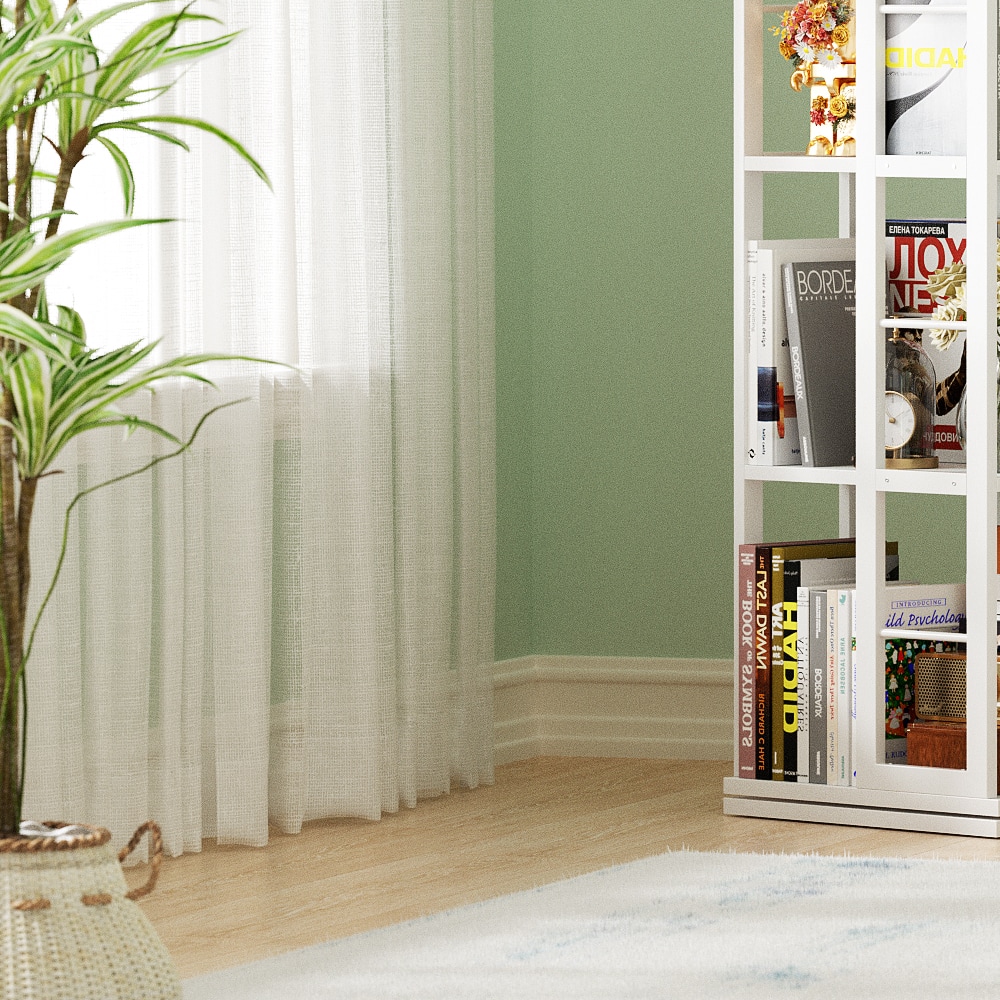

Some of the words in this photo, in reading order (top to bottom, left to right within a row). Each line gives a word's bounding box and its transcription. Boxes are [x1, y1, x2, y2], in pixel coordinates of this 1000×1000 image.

[889, 225, 910, 234] ЕЛЕНА
[911, 226, 946, 235] ТОКАРЕВА
[889, 236, 967, 280] ЛОХ
[797, 269, 856, 295] BORDE
[792, 346, 804, 400] BORDEAUX
[896, 599, 942, 608] INTRODUCING
